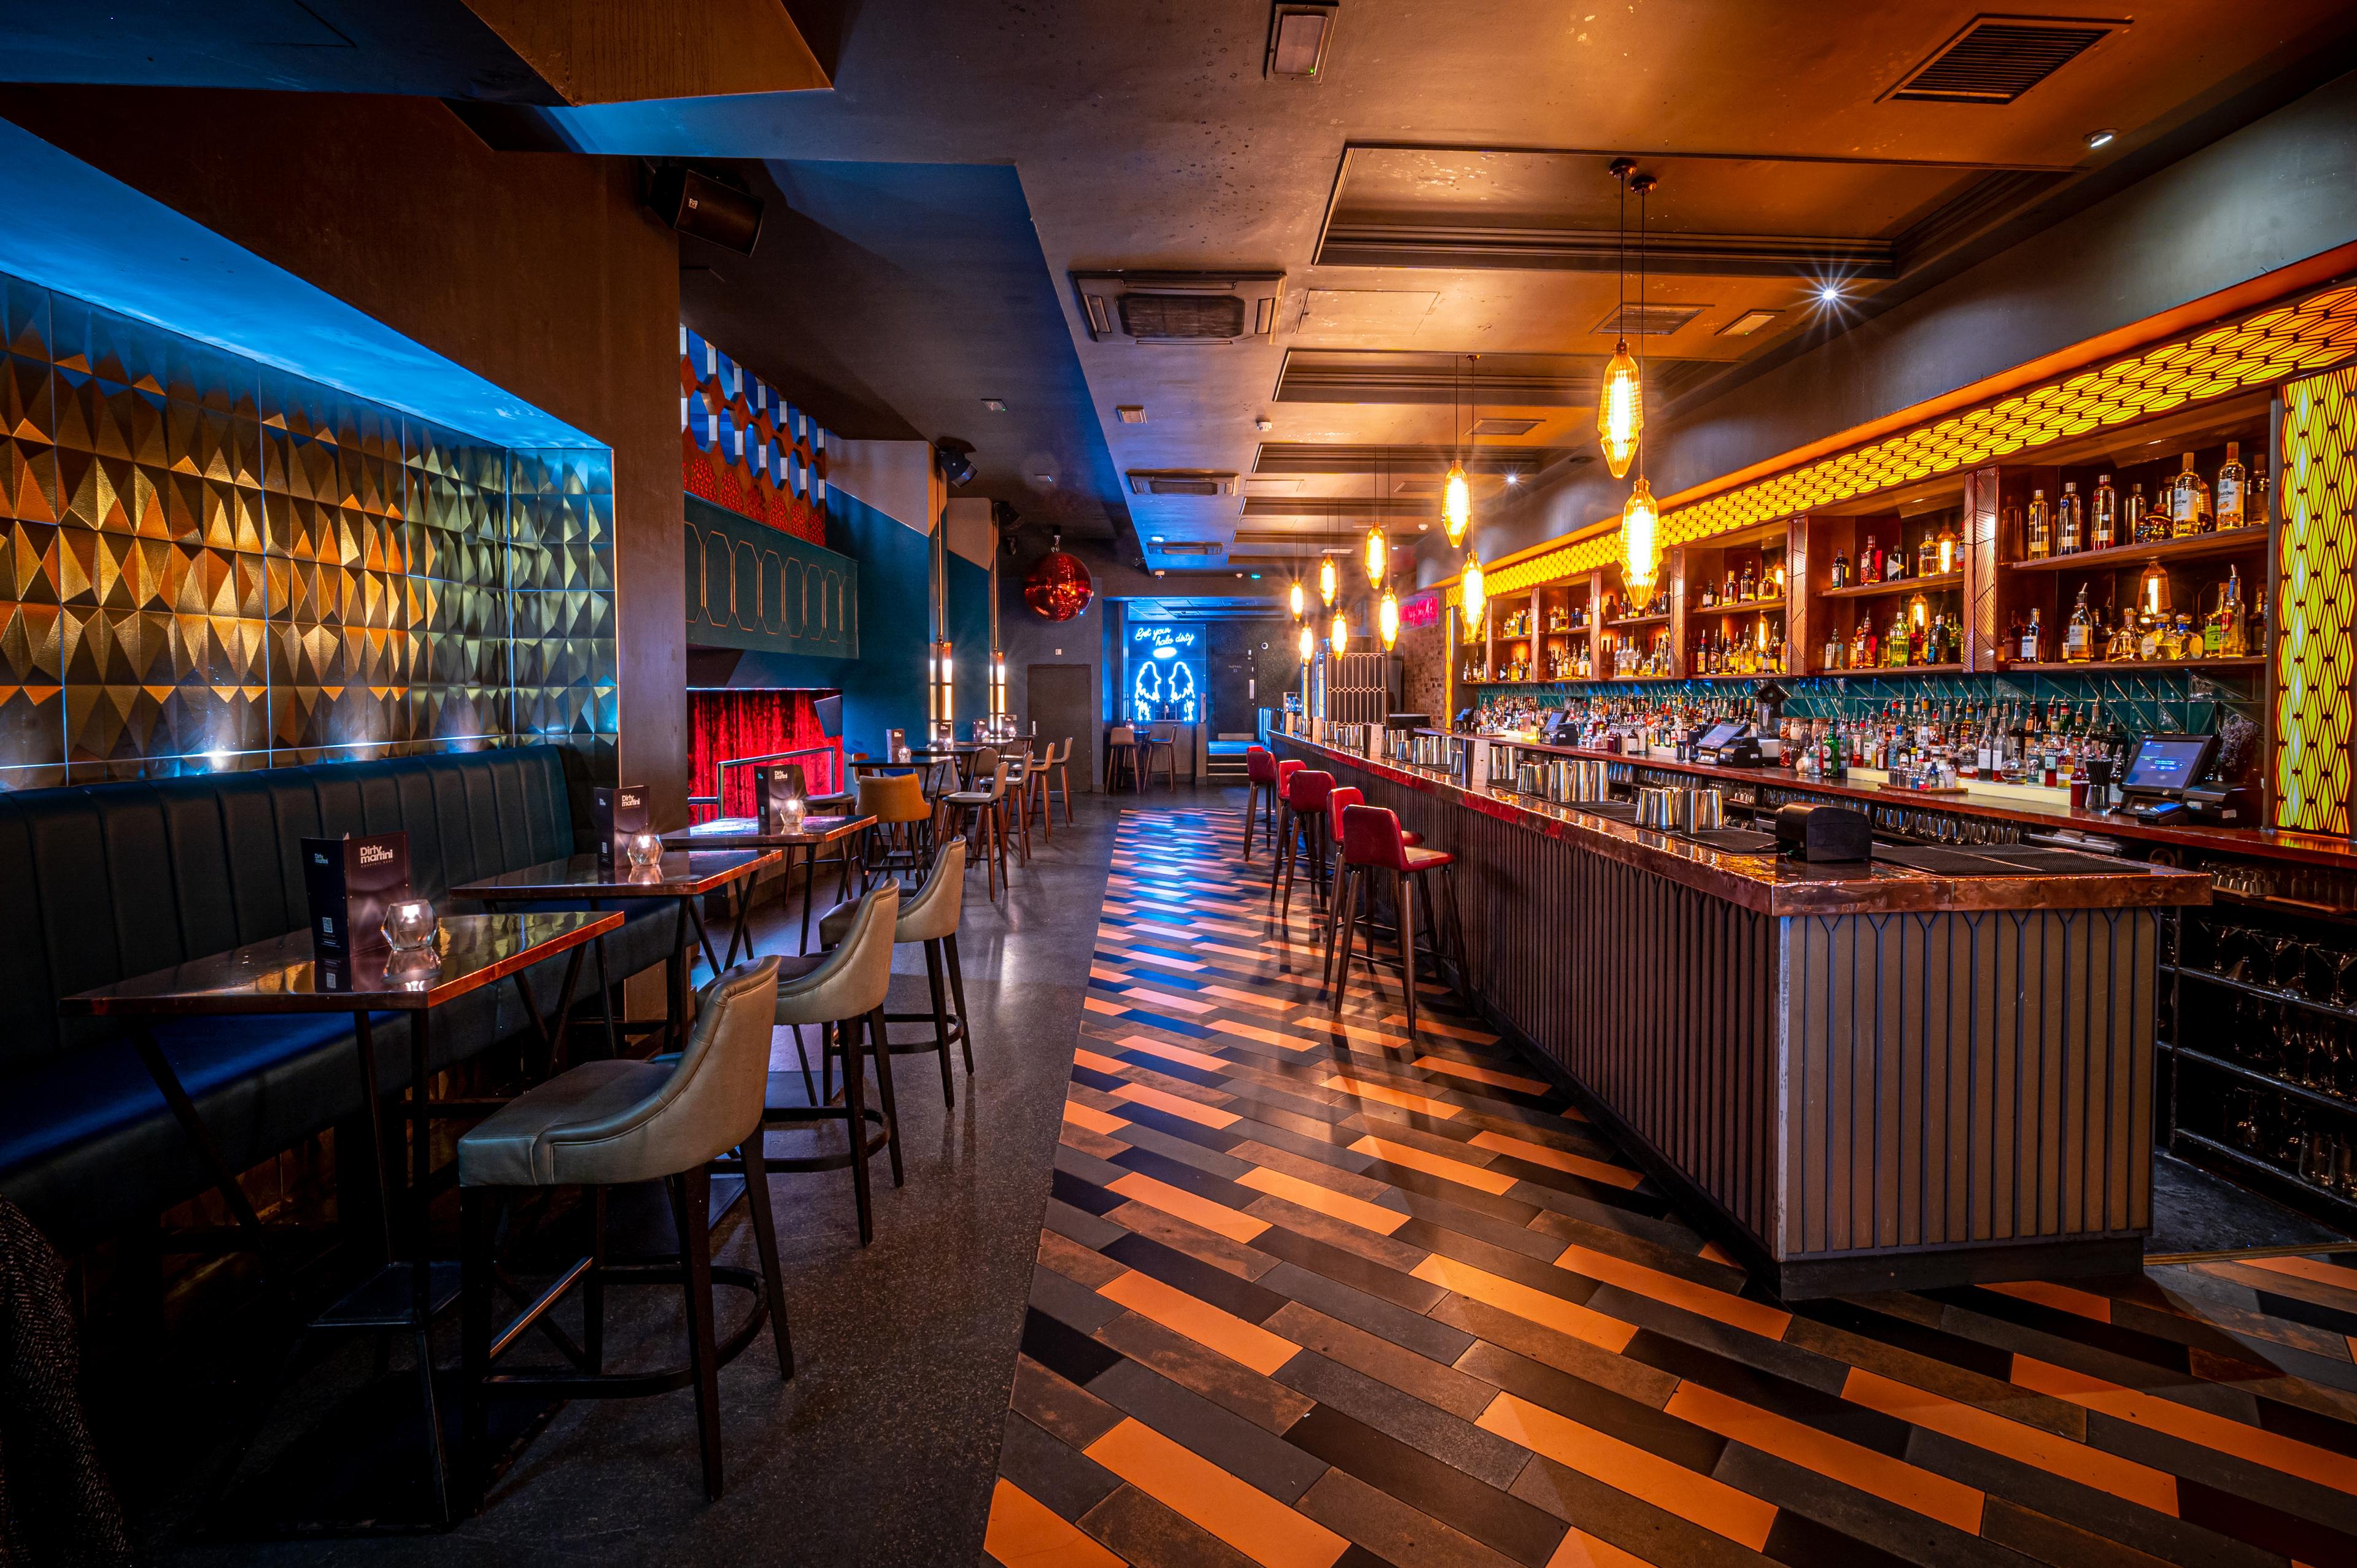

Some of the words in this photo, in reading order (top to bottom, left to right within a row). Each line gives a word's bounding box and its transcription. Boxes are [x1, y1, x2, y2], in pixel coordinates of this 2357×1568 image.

[1136, 627, 1151, 641] Get
[1152, 627, 1171, 641] your
[1155, 635, 1174, 646] halo
[1175, 633, 1194, 646] dirty
[622, 798, 640, 807] martini
[360, 845, 382, 856] Dirty
[361, 849, 393, 864] martini
